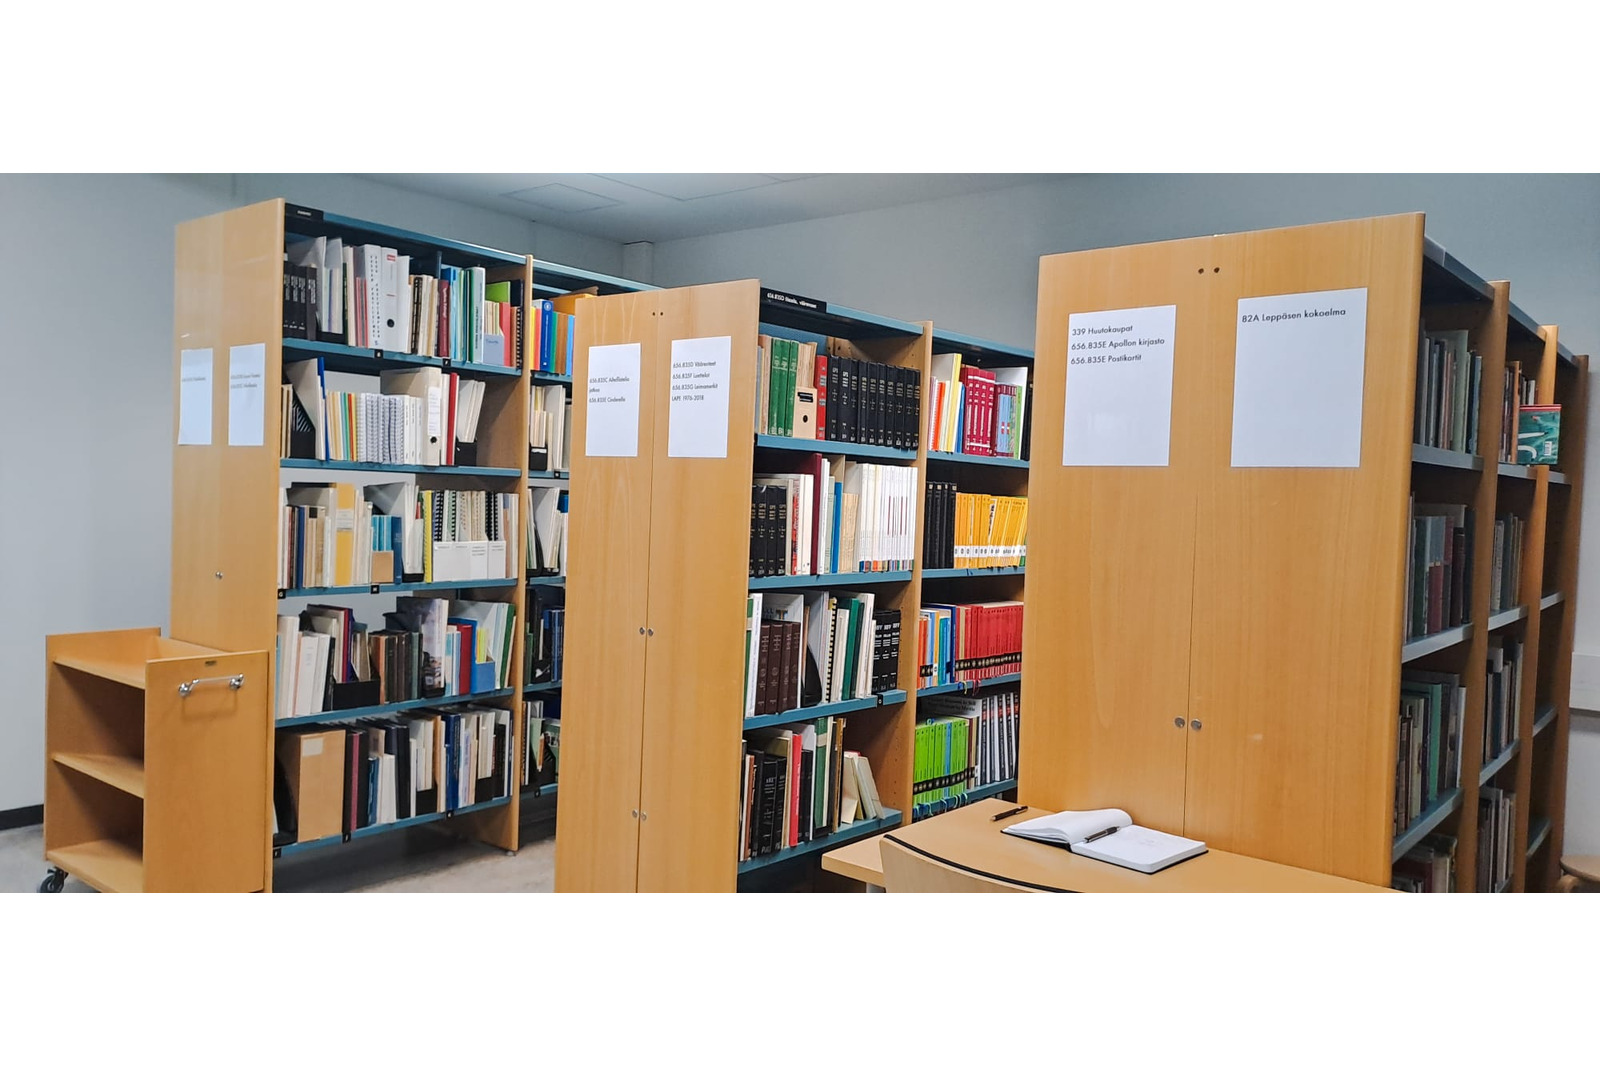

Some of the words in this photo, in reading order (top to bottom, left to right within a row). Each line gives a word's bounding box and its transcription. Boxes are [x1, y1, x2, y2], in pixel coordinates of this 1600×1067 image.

[1242, 314, 1260, 323] 82A
[1262, 312, 1302, 323] Leppäsen
[1304, 307, 1346, 318] kokoelma
[1072, 328, 1086, 336] 339
[1088, 325, 1133, 335] Huutokaupat
[1071, 340, 1107, 350] 656.835E
[1108, 339, 1137, 349] Apollon
[1138, 338, 1165, 347] kirjasto
[1070, 355, 1106, 365] 656.835E
[1108, 354, 1142, 363] Postikortit
